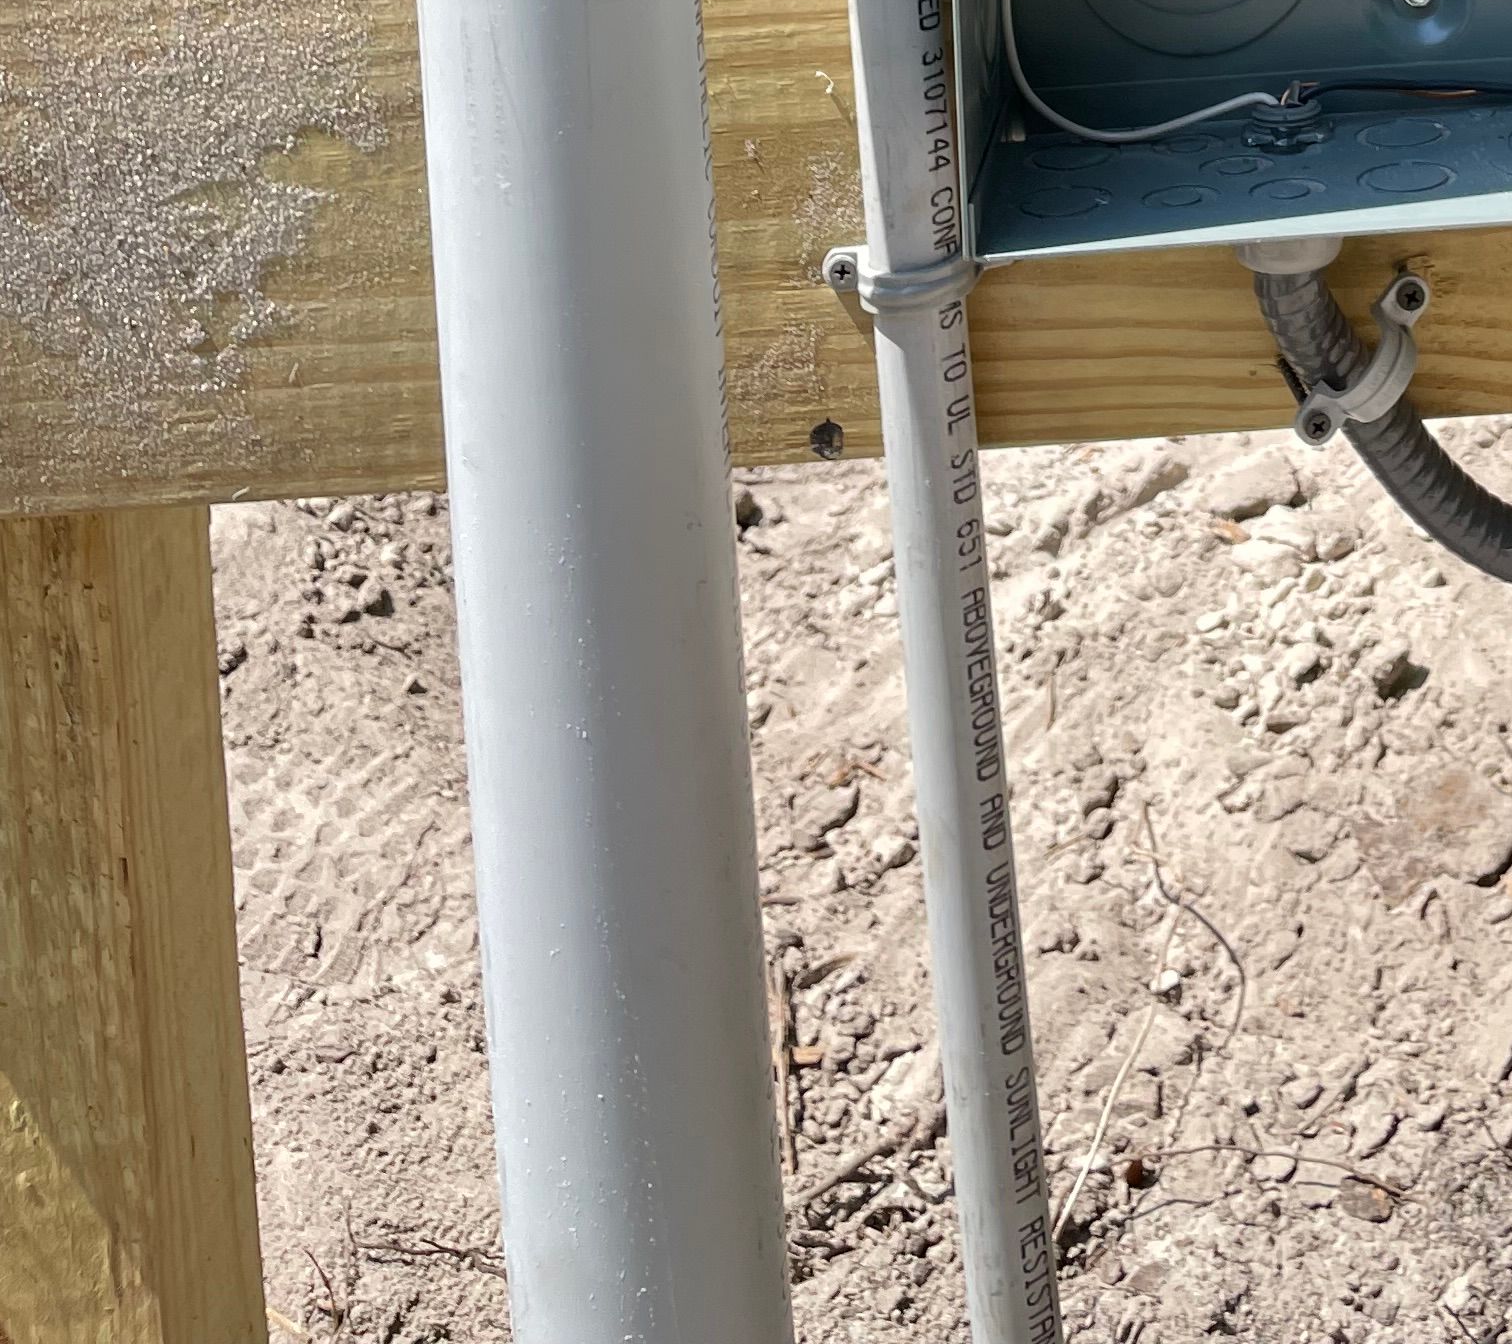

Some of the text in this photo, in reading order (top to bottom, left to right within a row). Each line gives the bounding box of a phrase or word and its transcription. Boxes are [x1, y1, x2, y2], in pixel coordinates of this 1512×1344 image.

[922, 47, 951, 172] 3107144
[941, 342, 968, 383] TO
[946, 394, 971, 435] UL
[951, 448, 977, 504] STD
[956, 518, 982, 572] 651
[961, 586, 1000, 782] ABOVEGROUND
[980, 793, 1007, 851] AND
[986, 861, 1026, 1056] UNDERGROUND
[1005, 1066, 1041, 1205] SUNLIGHT
